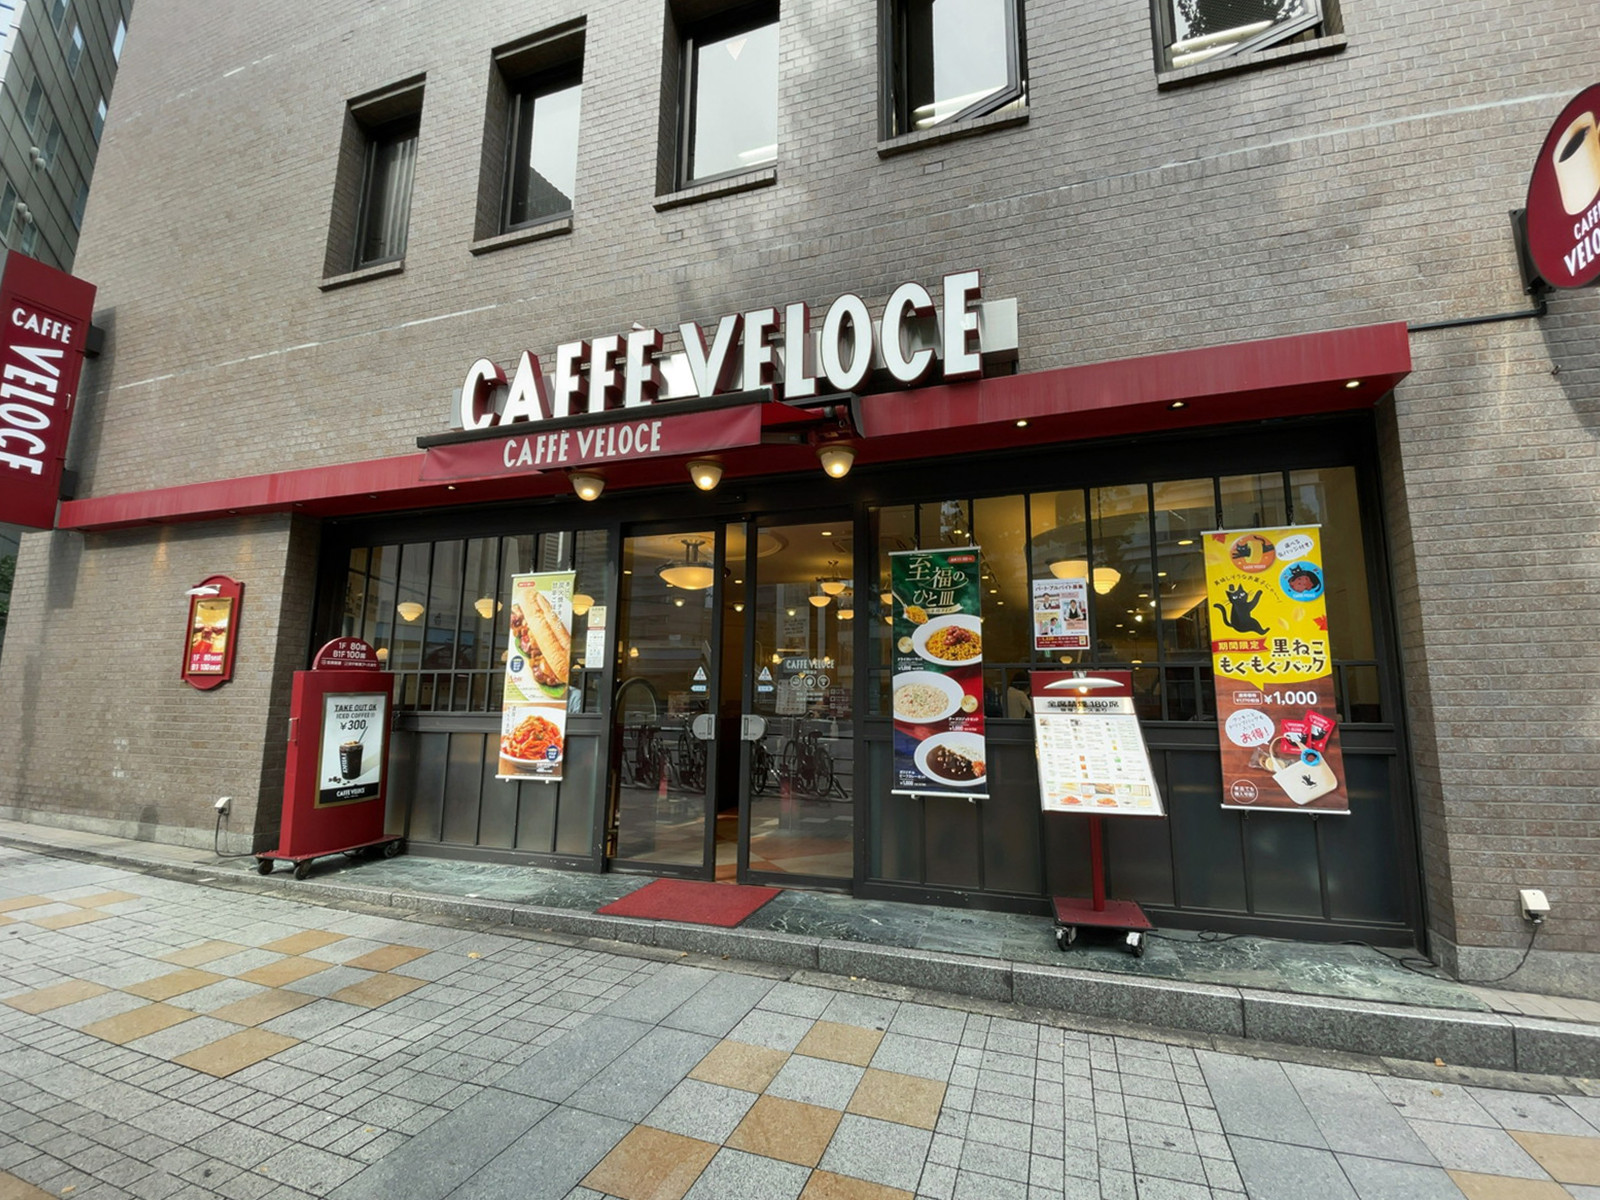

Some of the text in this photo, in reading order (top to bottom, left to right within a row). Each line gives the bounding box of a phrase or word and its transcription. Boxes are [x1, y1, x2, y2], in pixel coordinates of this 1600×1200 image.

[678, 268, 983, 399] VELOCE
[0, 345, 65, 476] VELOCE
[576, 421, 662, 459] VELOCE
[905, 553, 966, 589] 至福の
[912, 589, 955, 608] ひと皿
[339, 641, 347, 650] 1F
[1218, 640, 1260, 651] 期間限定
[1272, 638, 1324, 657] 黒ねこ
[1264, 690, 1318, 705] ¥1,000
[334, 704, 353, 712] TAKE
